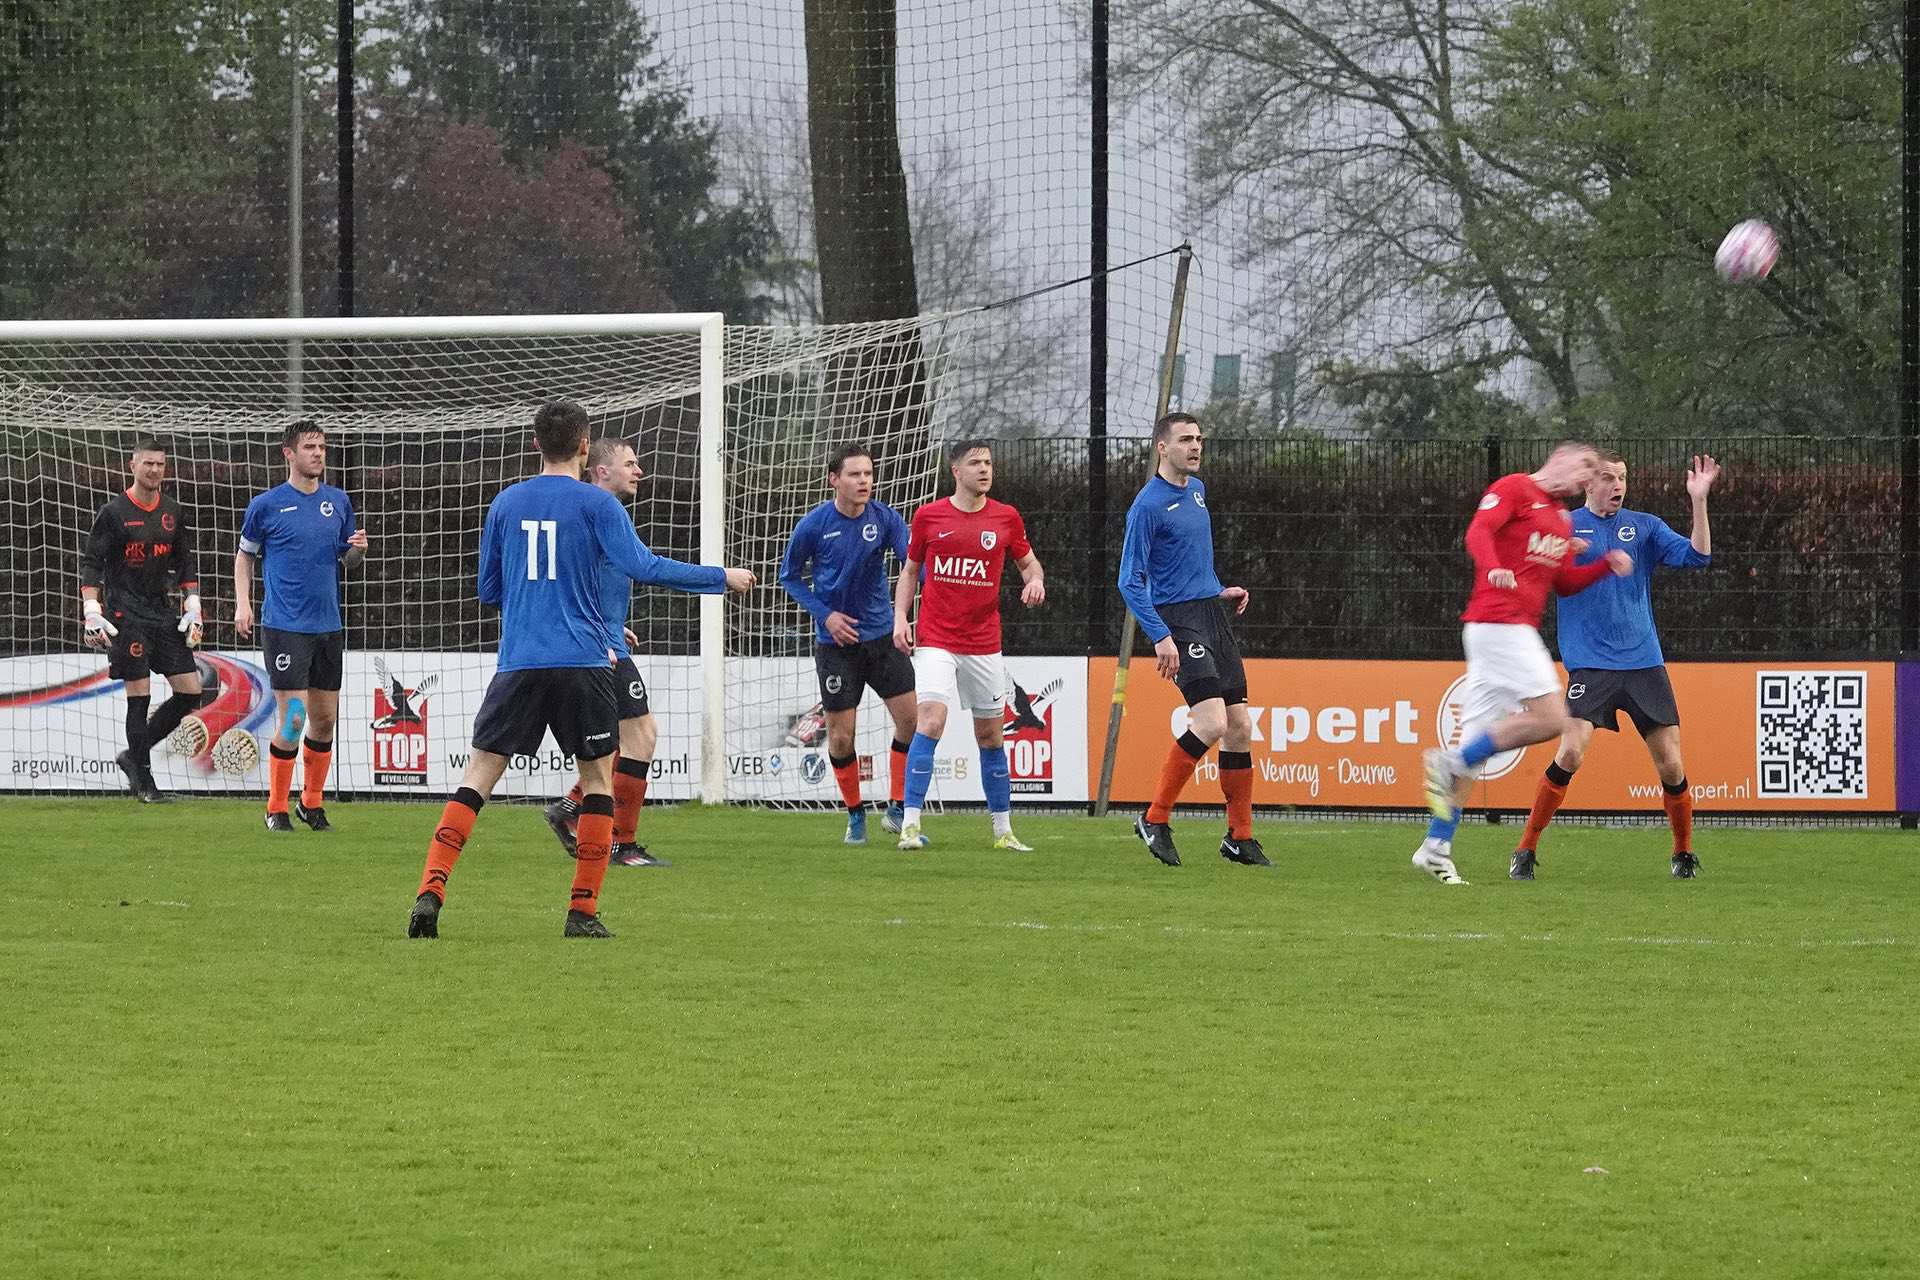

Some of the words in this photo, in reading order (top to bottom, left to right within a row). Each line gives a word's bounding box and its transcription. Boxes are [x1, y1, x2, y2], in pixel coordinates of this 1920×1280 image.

[521, 519, 557, 580] 11
[934, 555, 987, 579] MIFA
[12, 754, 116, 779] argowil.com
[375, 733, 426, 769] TOP
[728, 756, 763, 775] VEB
[1003, 740, 1051, 776] TOP
[1259, 757, 1319, 797] Venray
[1338, 757, 1397, 785] Deurne
